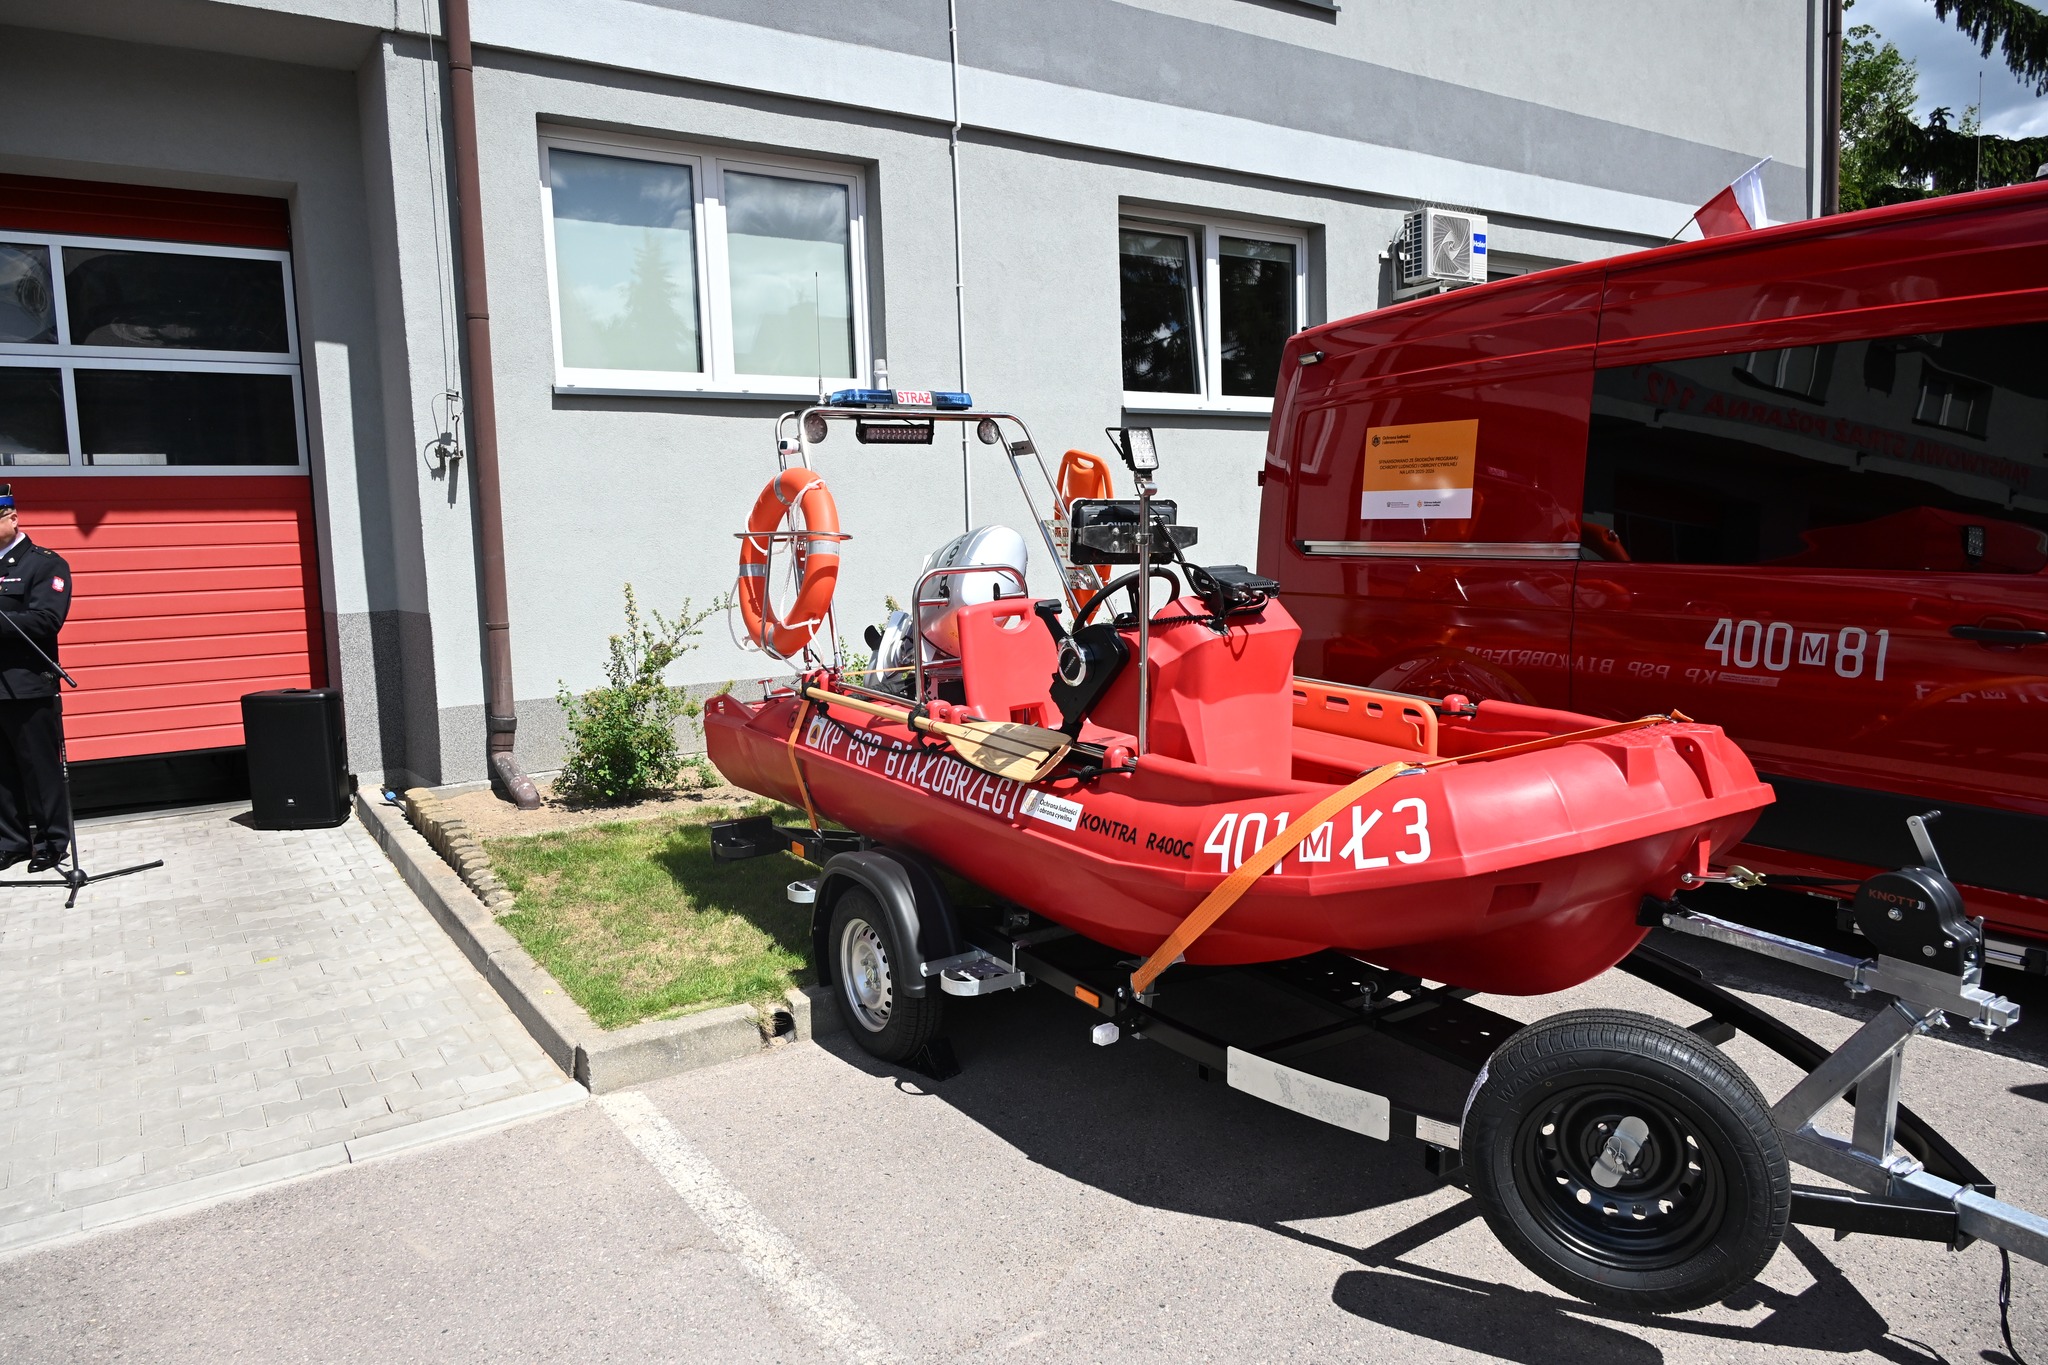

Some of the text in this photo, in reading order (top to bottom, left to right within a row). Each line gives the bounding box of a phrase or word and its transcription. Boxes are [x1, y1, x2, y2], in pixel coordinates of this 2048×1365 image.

[1704, 618, 1889, 681] 400 M 81
[820, 721, 1025, 819] KP PSP BIAŁOBRZEGI
[1039, 798, 1078, 816] Ochrona ludności
[1040, 807, 1055, 817] obrona
[1055, 812, 1072, 823] cywilna
[1079, 811, 1194, 859] KONTRA R400C
[1868, 889, 1916, 907] KNOTT
